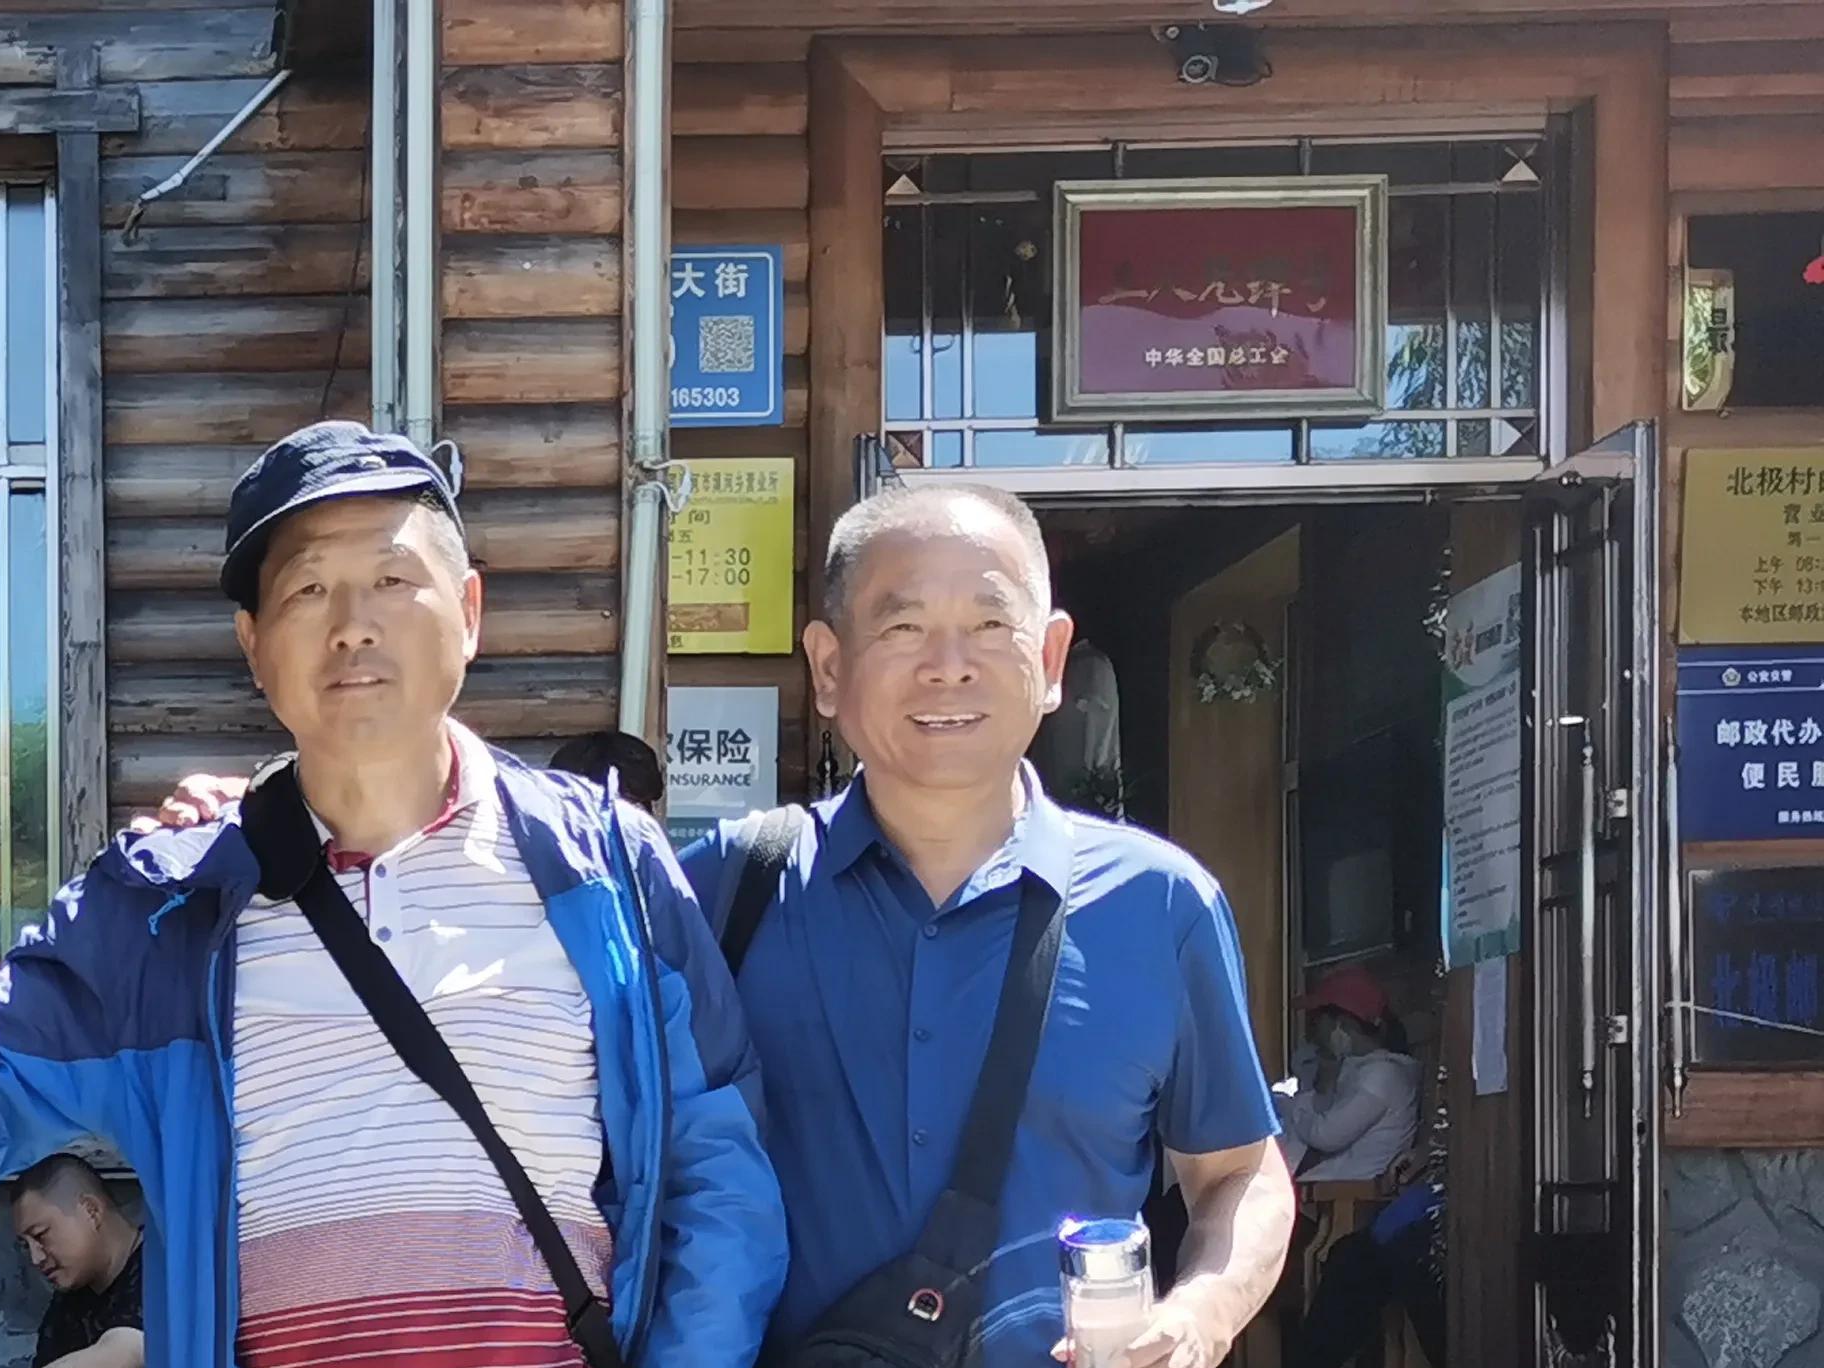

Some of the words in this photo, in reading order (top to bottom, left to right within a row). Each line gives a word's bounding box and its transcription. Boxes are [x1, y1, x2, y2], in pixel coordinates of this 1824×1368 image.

[672, 262, 749, 298] 大街
[1144, 347, 1290, 367] 中华全国总工会
[1726, 466, 1824, 496] 北极村
[667, 728, 752, 764] 保险
[1716, 717, 1822, 747] 邮政代办
[670, 773, 752, 787] NSURANCE
